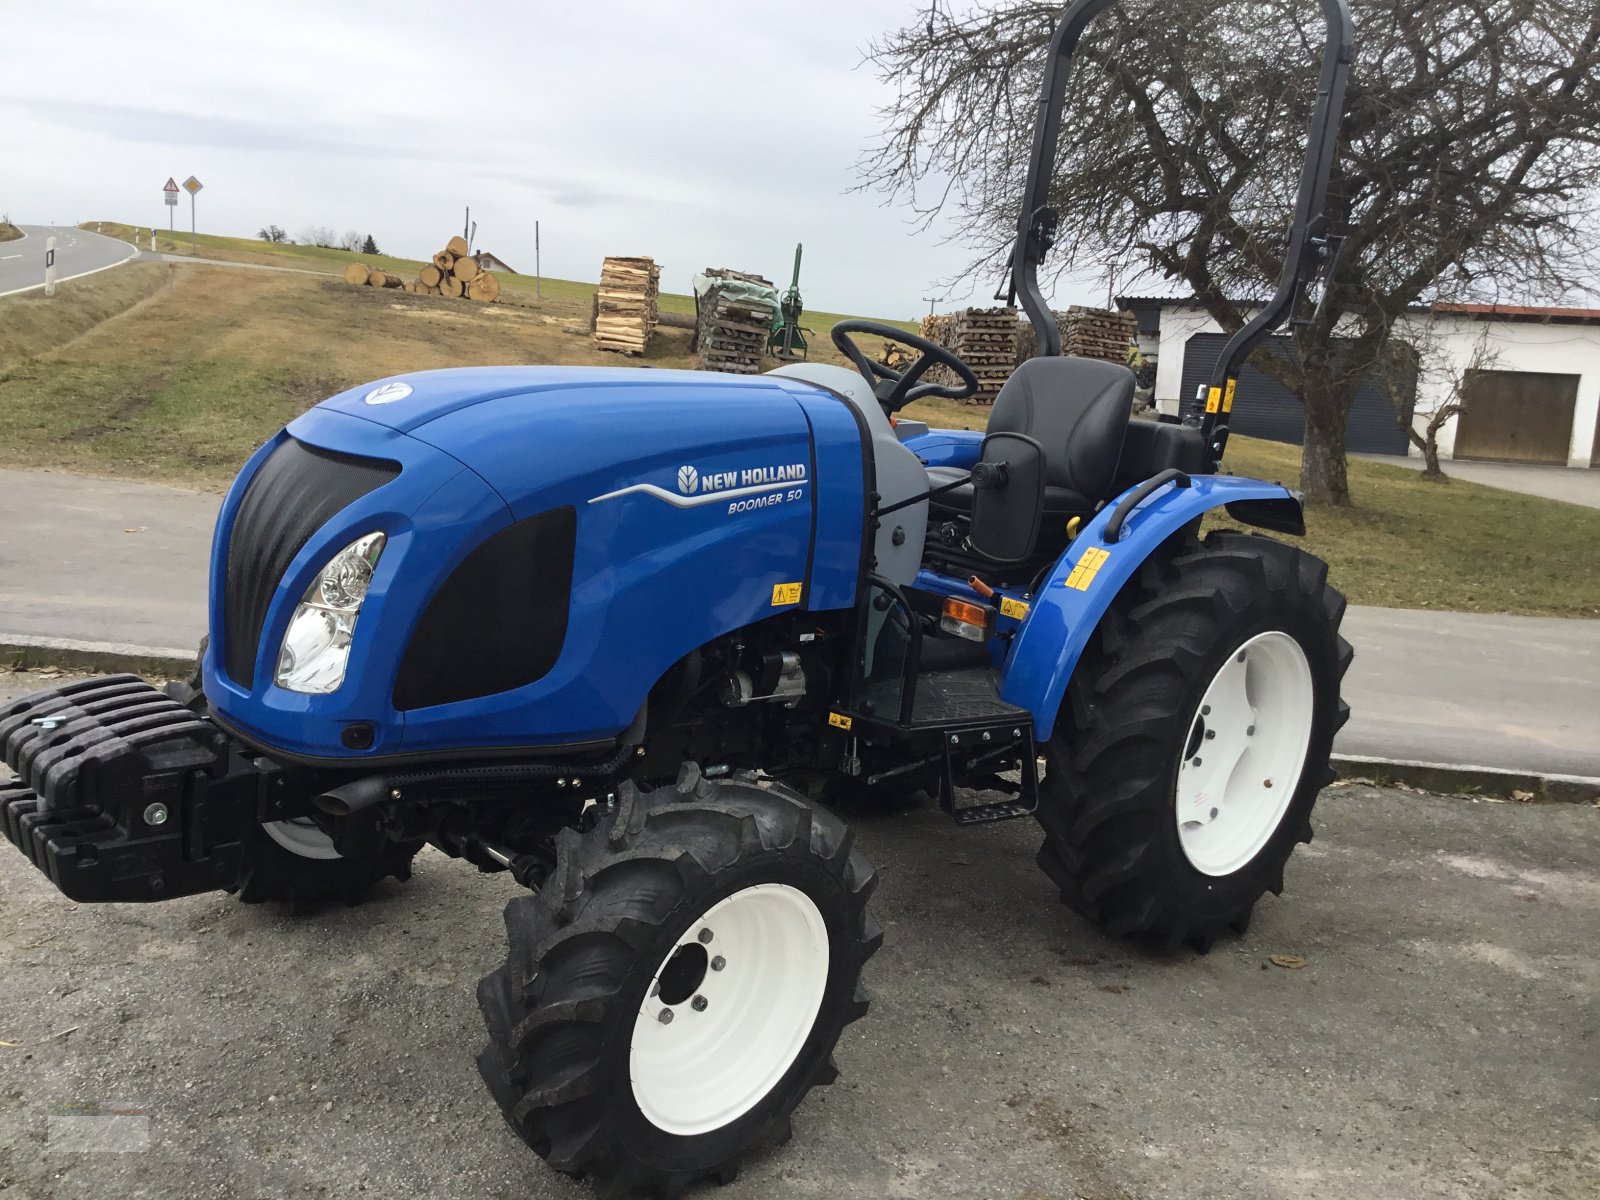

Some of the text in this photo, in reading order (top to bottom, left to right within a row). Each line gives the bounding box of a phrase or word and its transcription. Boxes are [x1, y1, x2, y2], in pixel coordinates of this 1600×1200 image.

[702, 463, 806, 492] NEW HOLLAND
[727, 488, 803, 515] BOOMER 50
